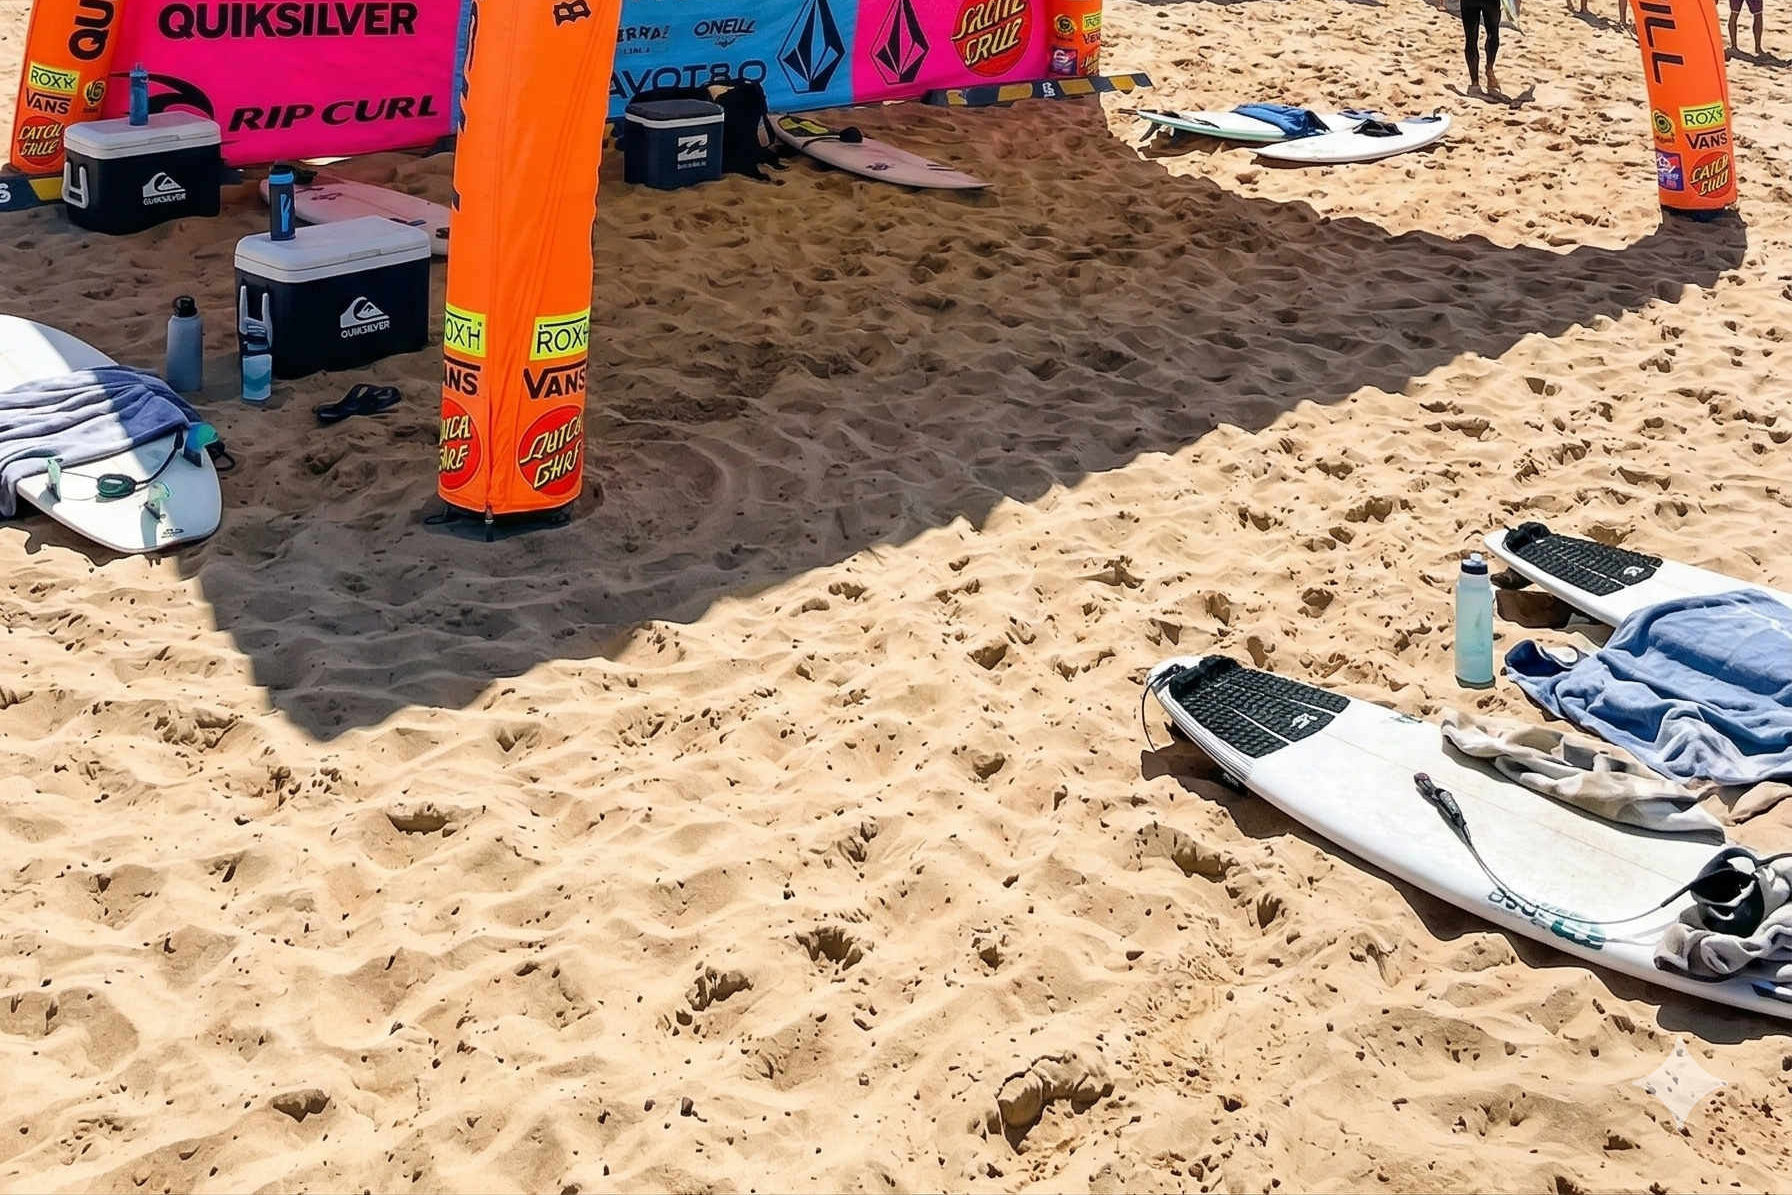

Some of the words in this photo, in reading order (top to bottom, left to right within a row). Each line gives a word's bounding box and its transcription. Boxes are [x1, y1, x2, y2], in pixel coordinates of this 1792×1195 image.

[158, 2, 419, 41] QUIKSILVER
[26, 88, 72, 115] VANS
[228, 104, 314, 133] RIP
[321, 95, 439, 125] CURL
[1685, 128, 1728, 149] VANS
[444, 355, 480, 396] ANS
[523, 358, 587, 400] VANS
